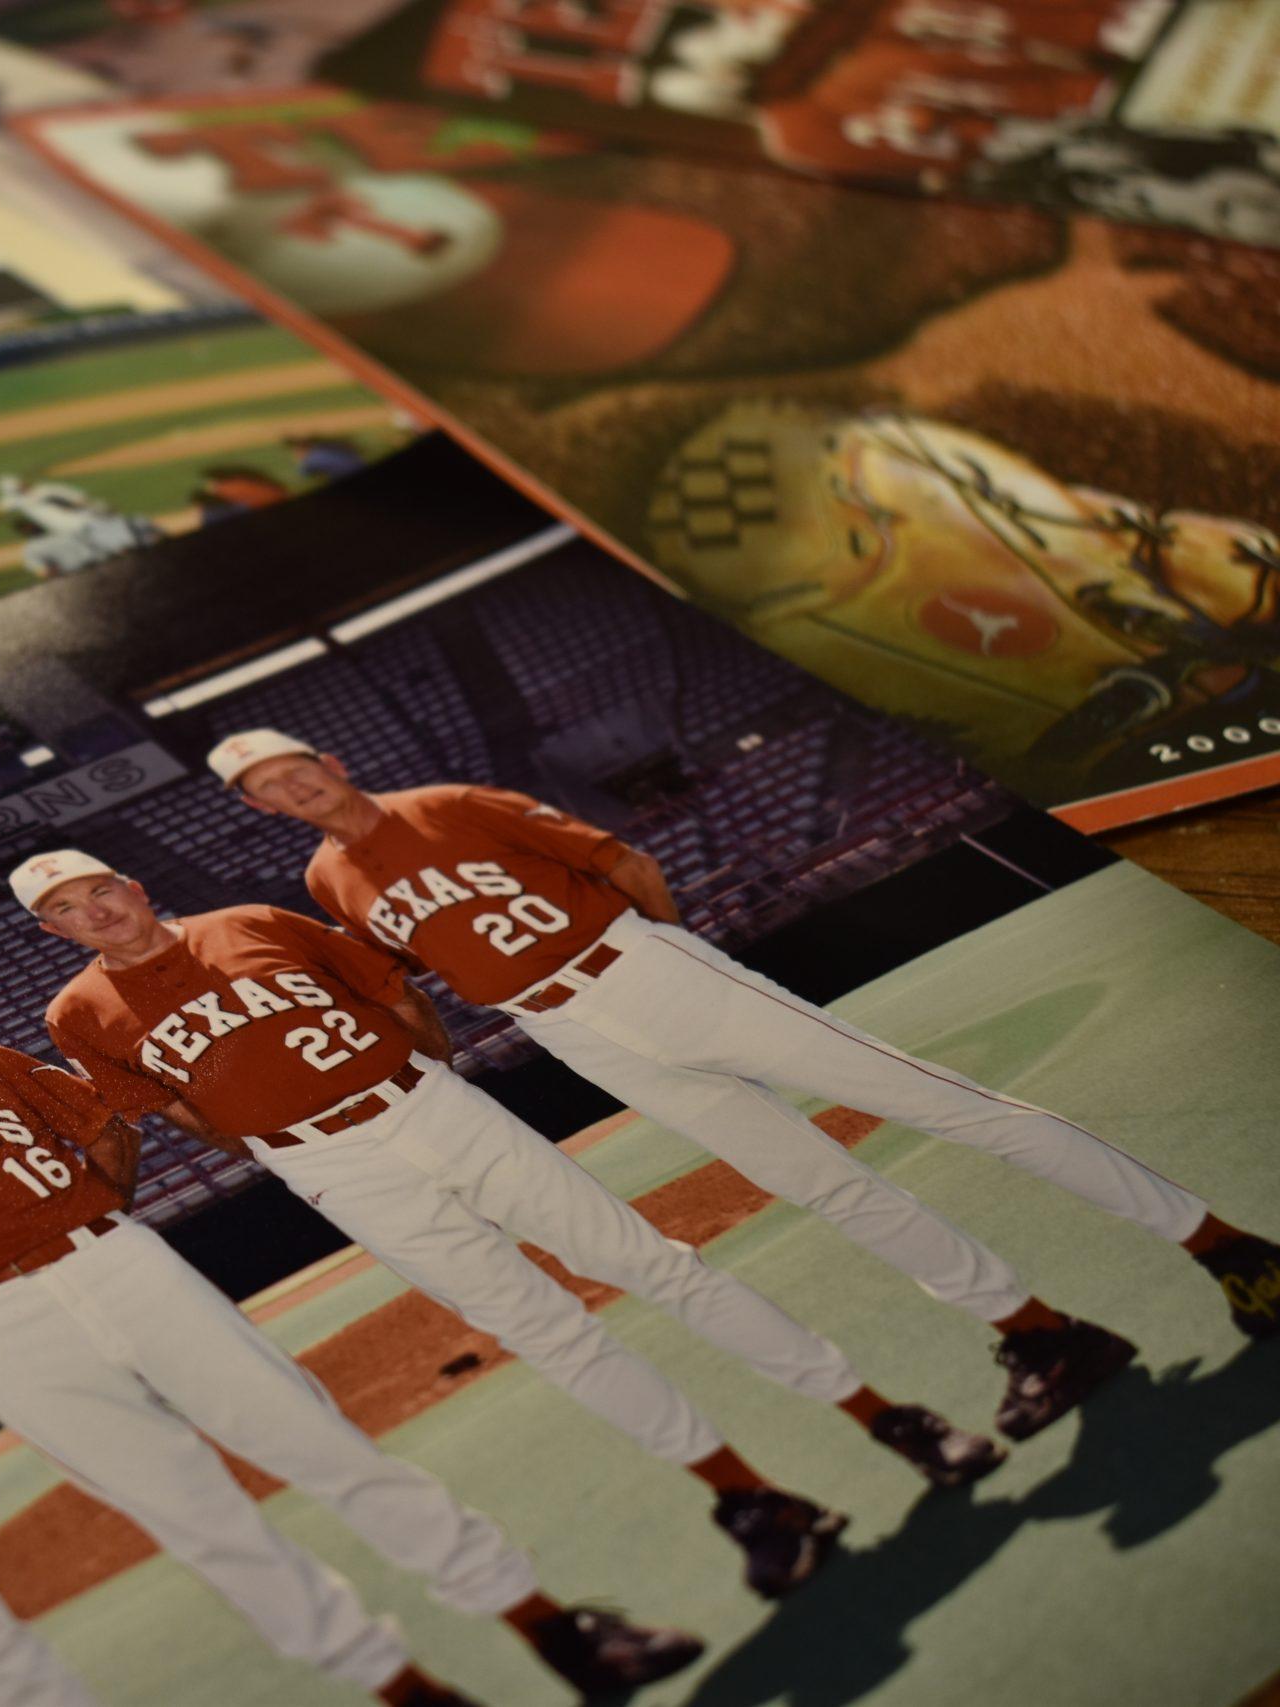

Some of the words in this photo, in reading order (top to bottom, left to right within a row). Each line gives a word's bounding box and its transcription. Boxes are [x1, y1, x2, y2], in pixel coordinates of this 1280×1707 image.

[1149, 718, 1280, 763] 2000
[367, 862, 522, 950] EXAS
[472, 895, 570, 956] 20
[141, 973, 334, 1084] TEXAS
[284, 1009, 380, 1072] 22
[2, 1146, 72, 1199] 16
